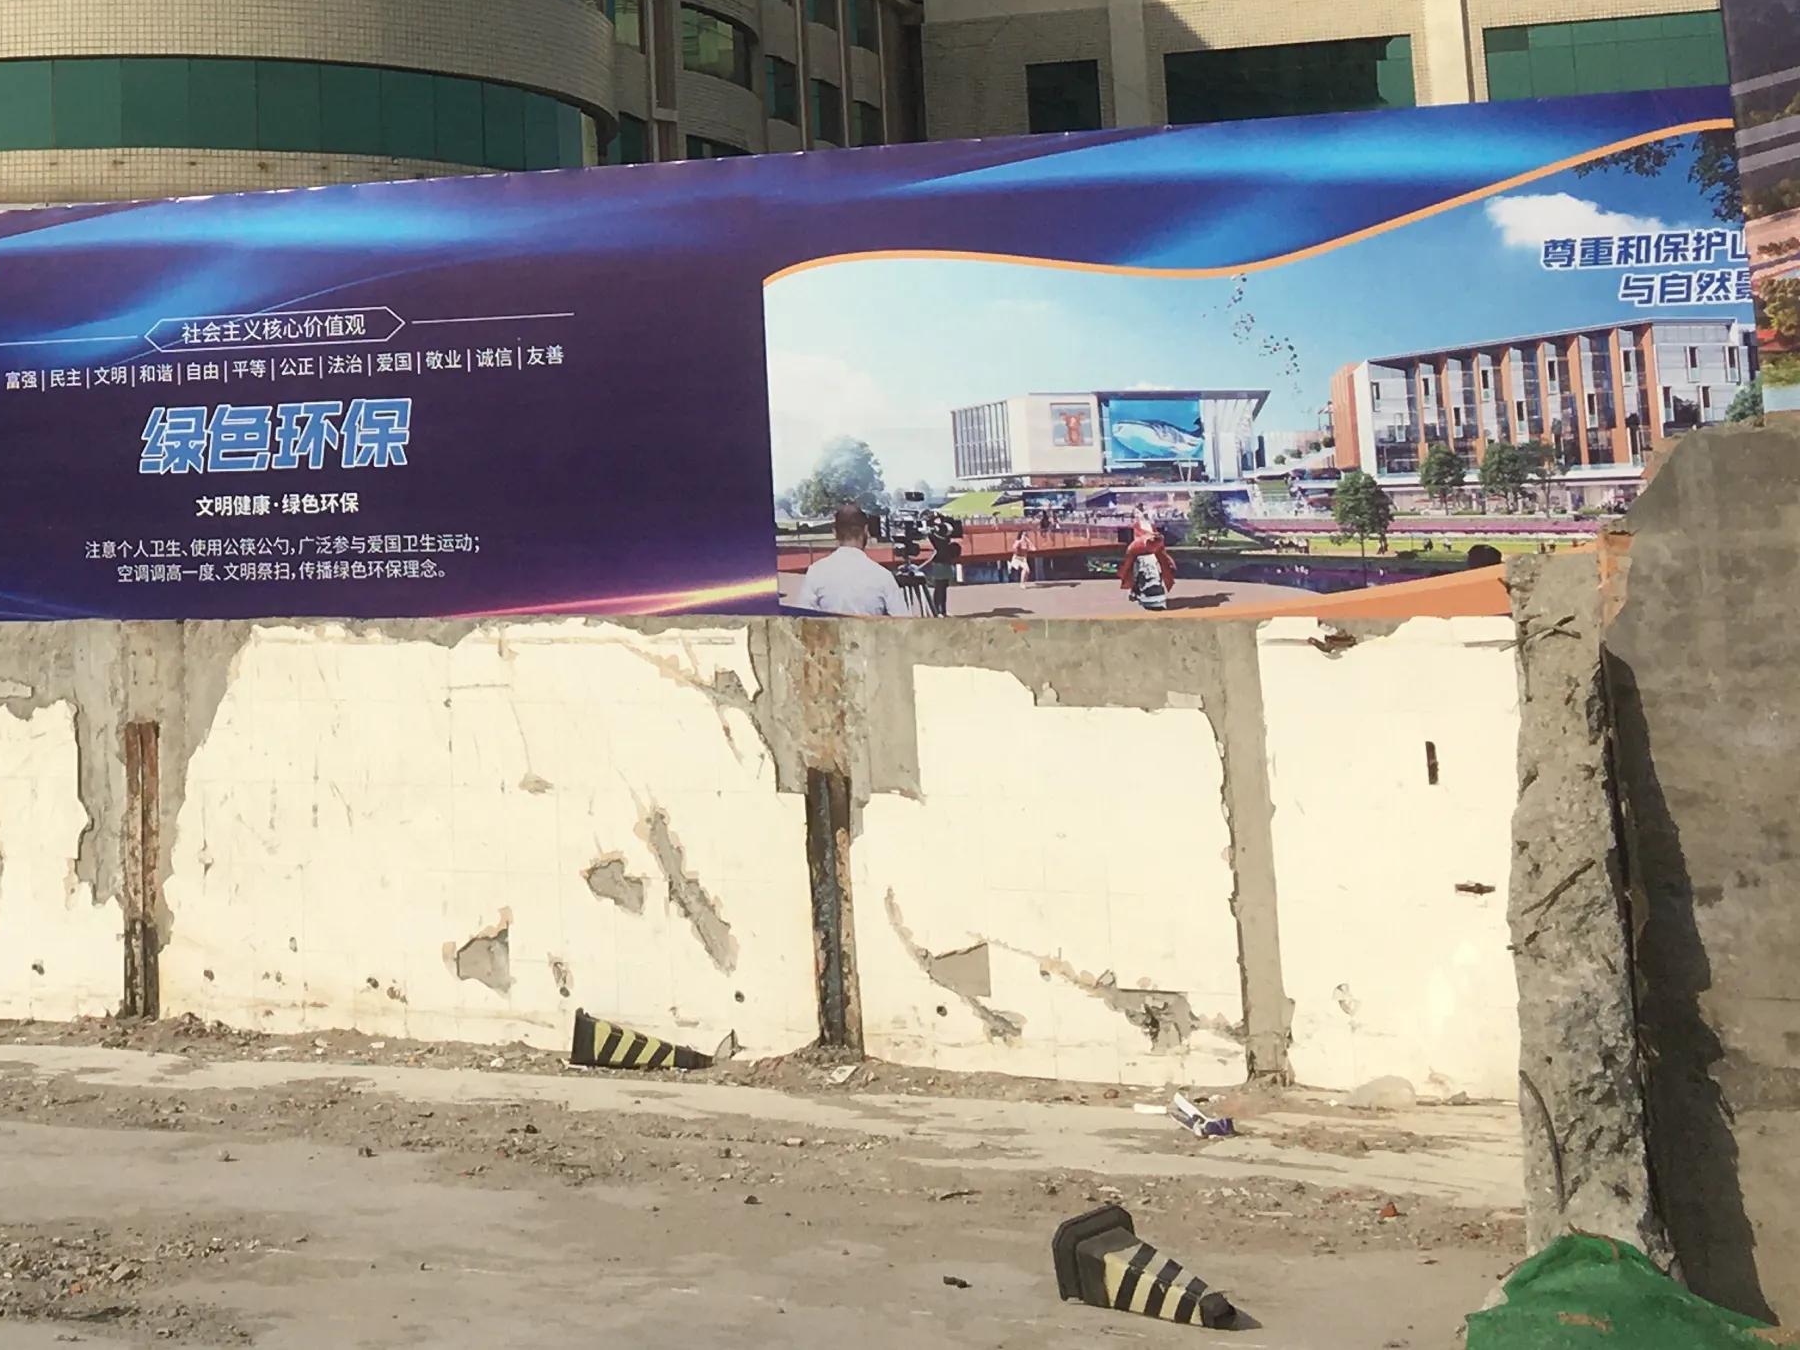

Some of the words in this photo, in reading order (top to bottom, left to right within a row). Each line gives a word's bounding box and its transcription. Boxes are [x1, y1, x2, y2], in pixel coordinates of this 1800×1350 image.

[182, 313, 366, 345] 社会主义核心价值观
[4, 370, 38, 391] 富强
[50, 368, 82, 389] 民主
[93, 366, 128, 386] 文明
[138, 363, 174, 383] 和谐
[186, 361, 220, 381] 自由
[232, 359, 267, 379] 平等
[279, 357, 315, 377] 公正
[327, 355, 363, 375] 法治
[376, 352, 413, 373] 爱国
[425, 349, 462, 370] 敬业
[475, 347, 513, 368] 诚信
[526, 344, 565, 366] 友善
[138, 397, 412, 475] 绿色环保
[195, 491, 360, 518] 文明健康·绿色环保
